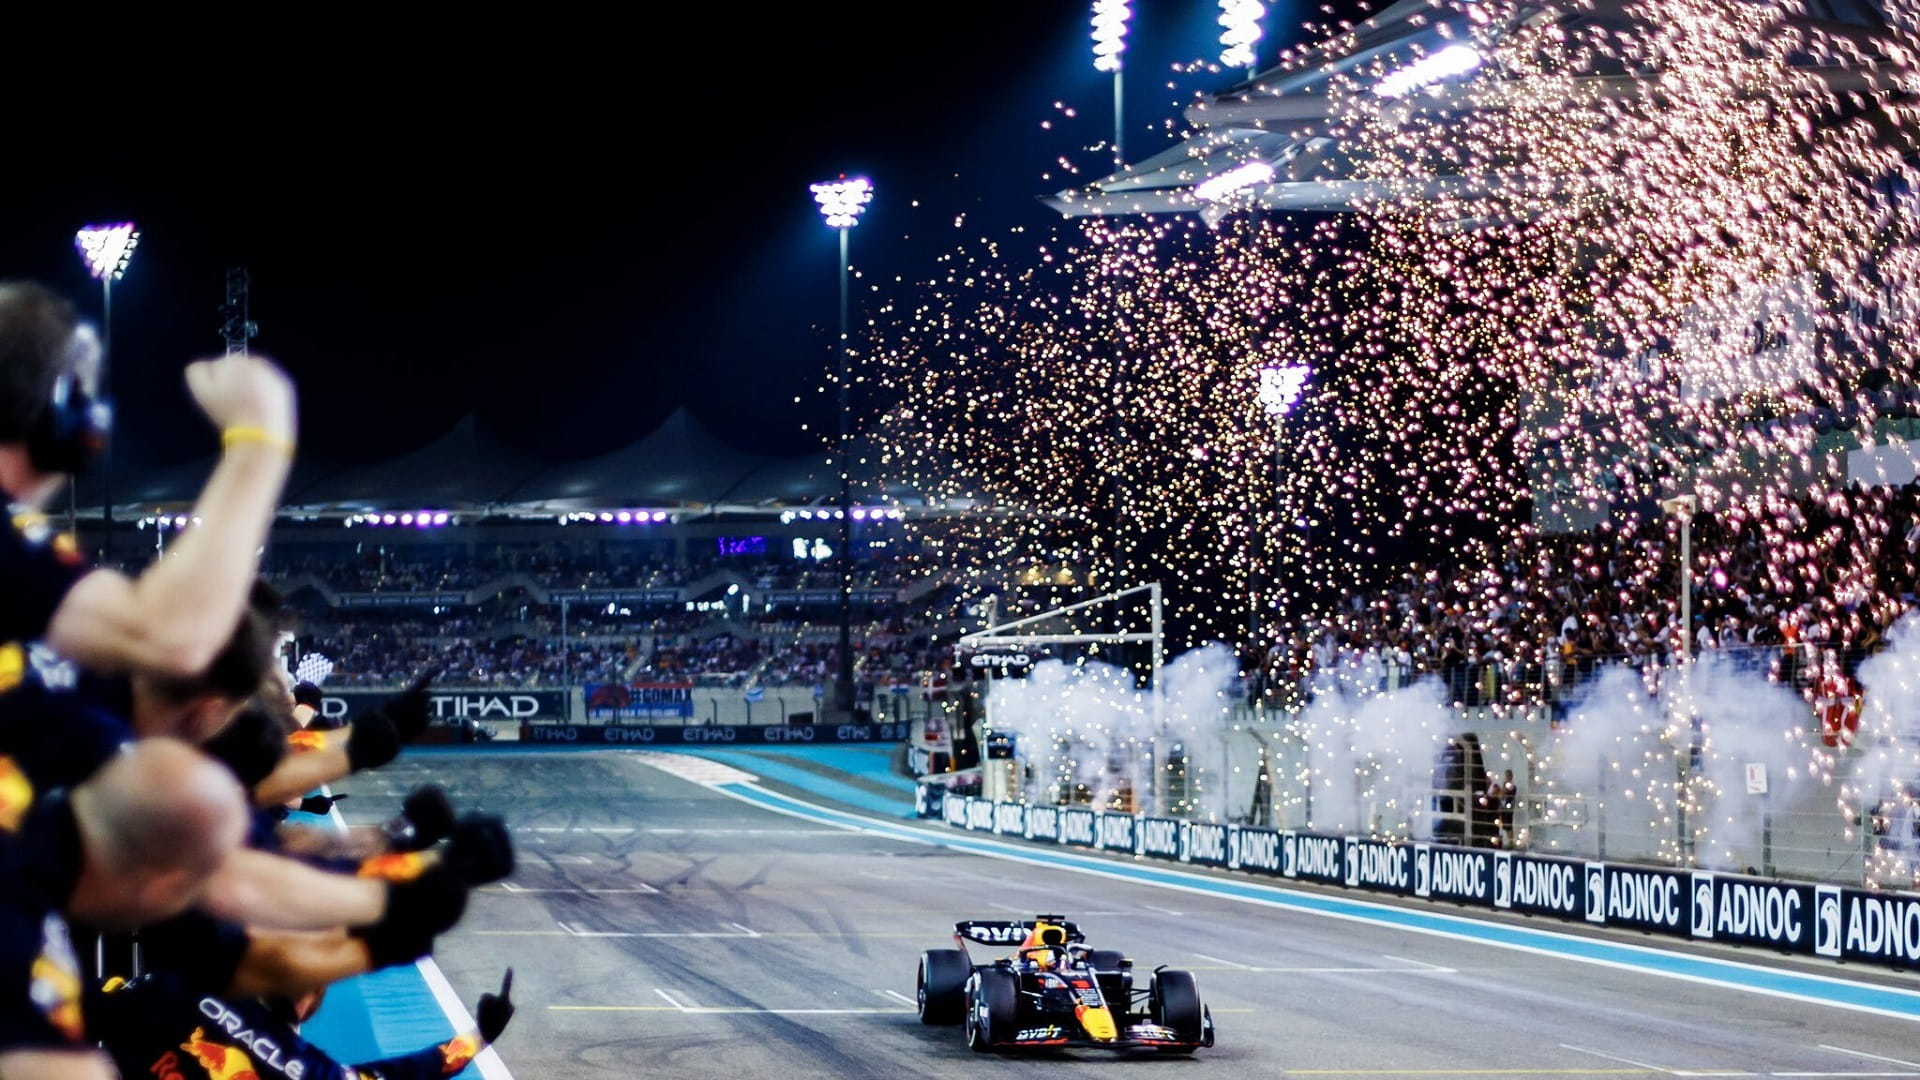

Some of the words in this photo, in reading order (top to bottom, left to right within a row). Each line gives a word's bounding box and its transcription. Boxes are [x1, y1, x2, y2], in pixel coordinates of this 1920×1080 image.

[970, 654, 1030, 667] ETIHAD
[428, 695, 539, 717] TIHAD
[604, 727, 655, 742] ETIHAD
[683, 727, 735, 742] ETIHAD
[764, 726, 814, 741] ETIHAD
[1190, 825, 1225, 861] ADNOC
[1240, 830, 1279, 870] ADNOC
[1297, 835, 1340, 879] ADNOC
[1359, 844, 1408, 888] ADNOC
[1432, 851, 1486, 898] ADNOC
[1513, 860, 1576, 912] ADNOC
[1608, 871, 1680, 926] ADNOC
[1717, 883, 1802, 943] ADNOC
[1846, 896, 1920, 961] ADNO
[199, 997, 305, 1080] ORACLE
